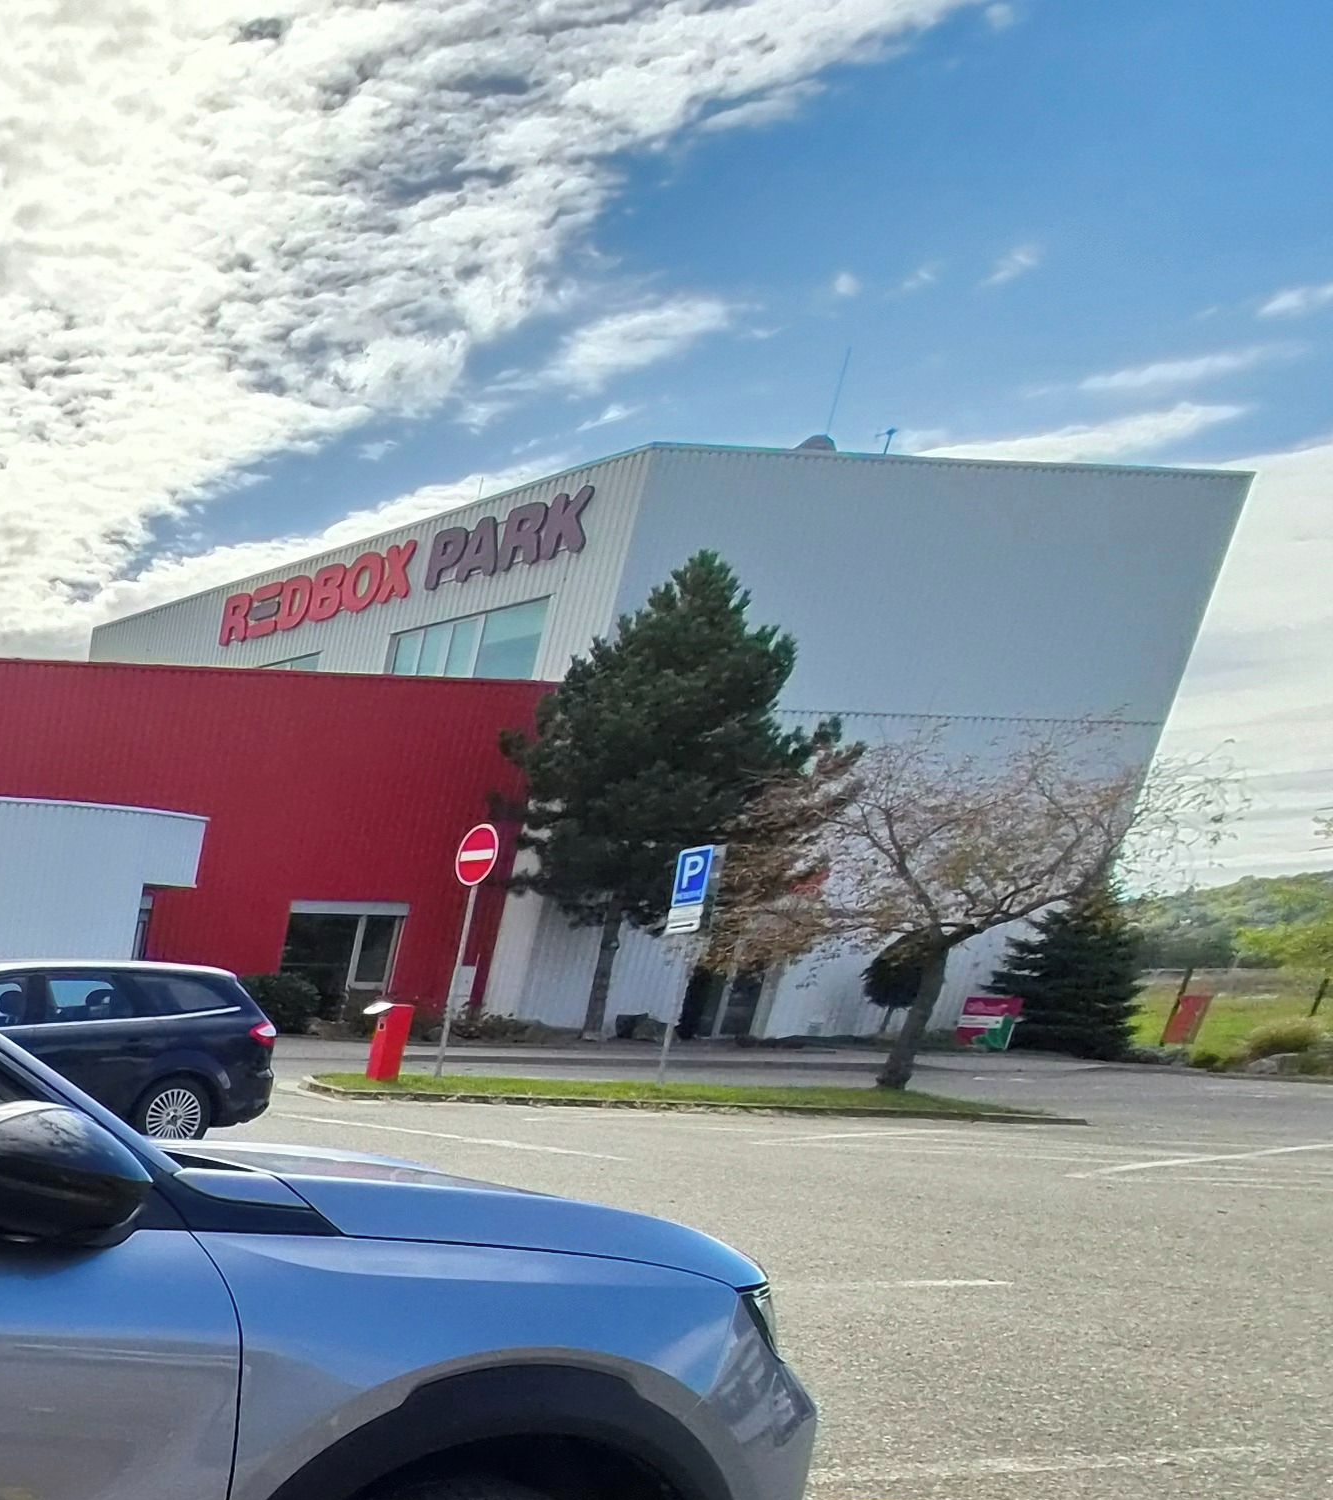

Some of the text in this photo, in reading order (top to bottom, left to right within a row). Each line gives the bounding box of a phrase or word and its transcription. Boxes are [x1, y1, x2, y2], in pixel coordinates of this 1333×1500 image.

[219, 484, 595, 647] REDBOX PARK
[681, 855, 705, 889] P
